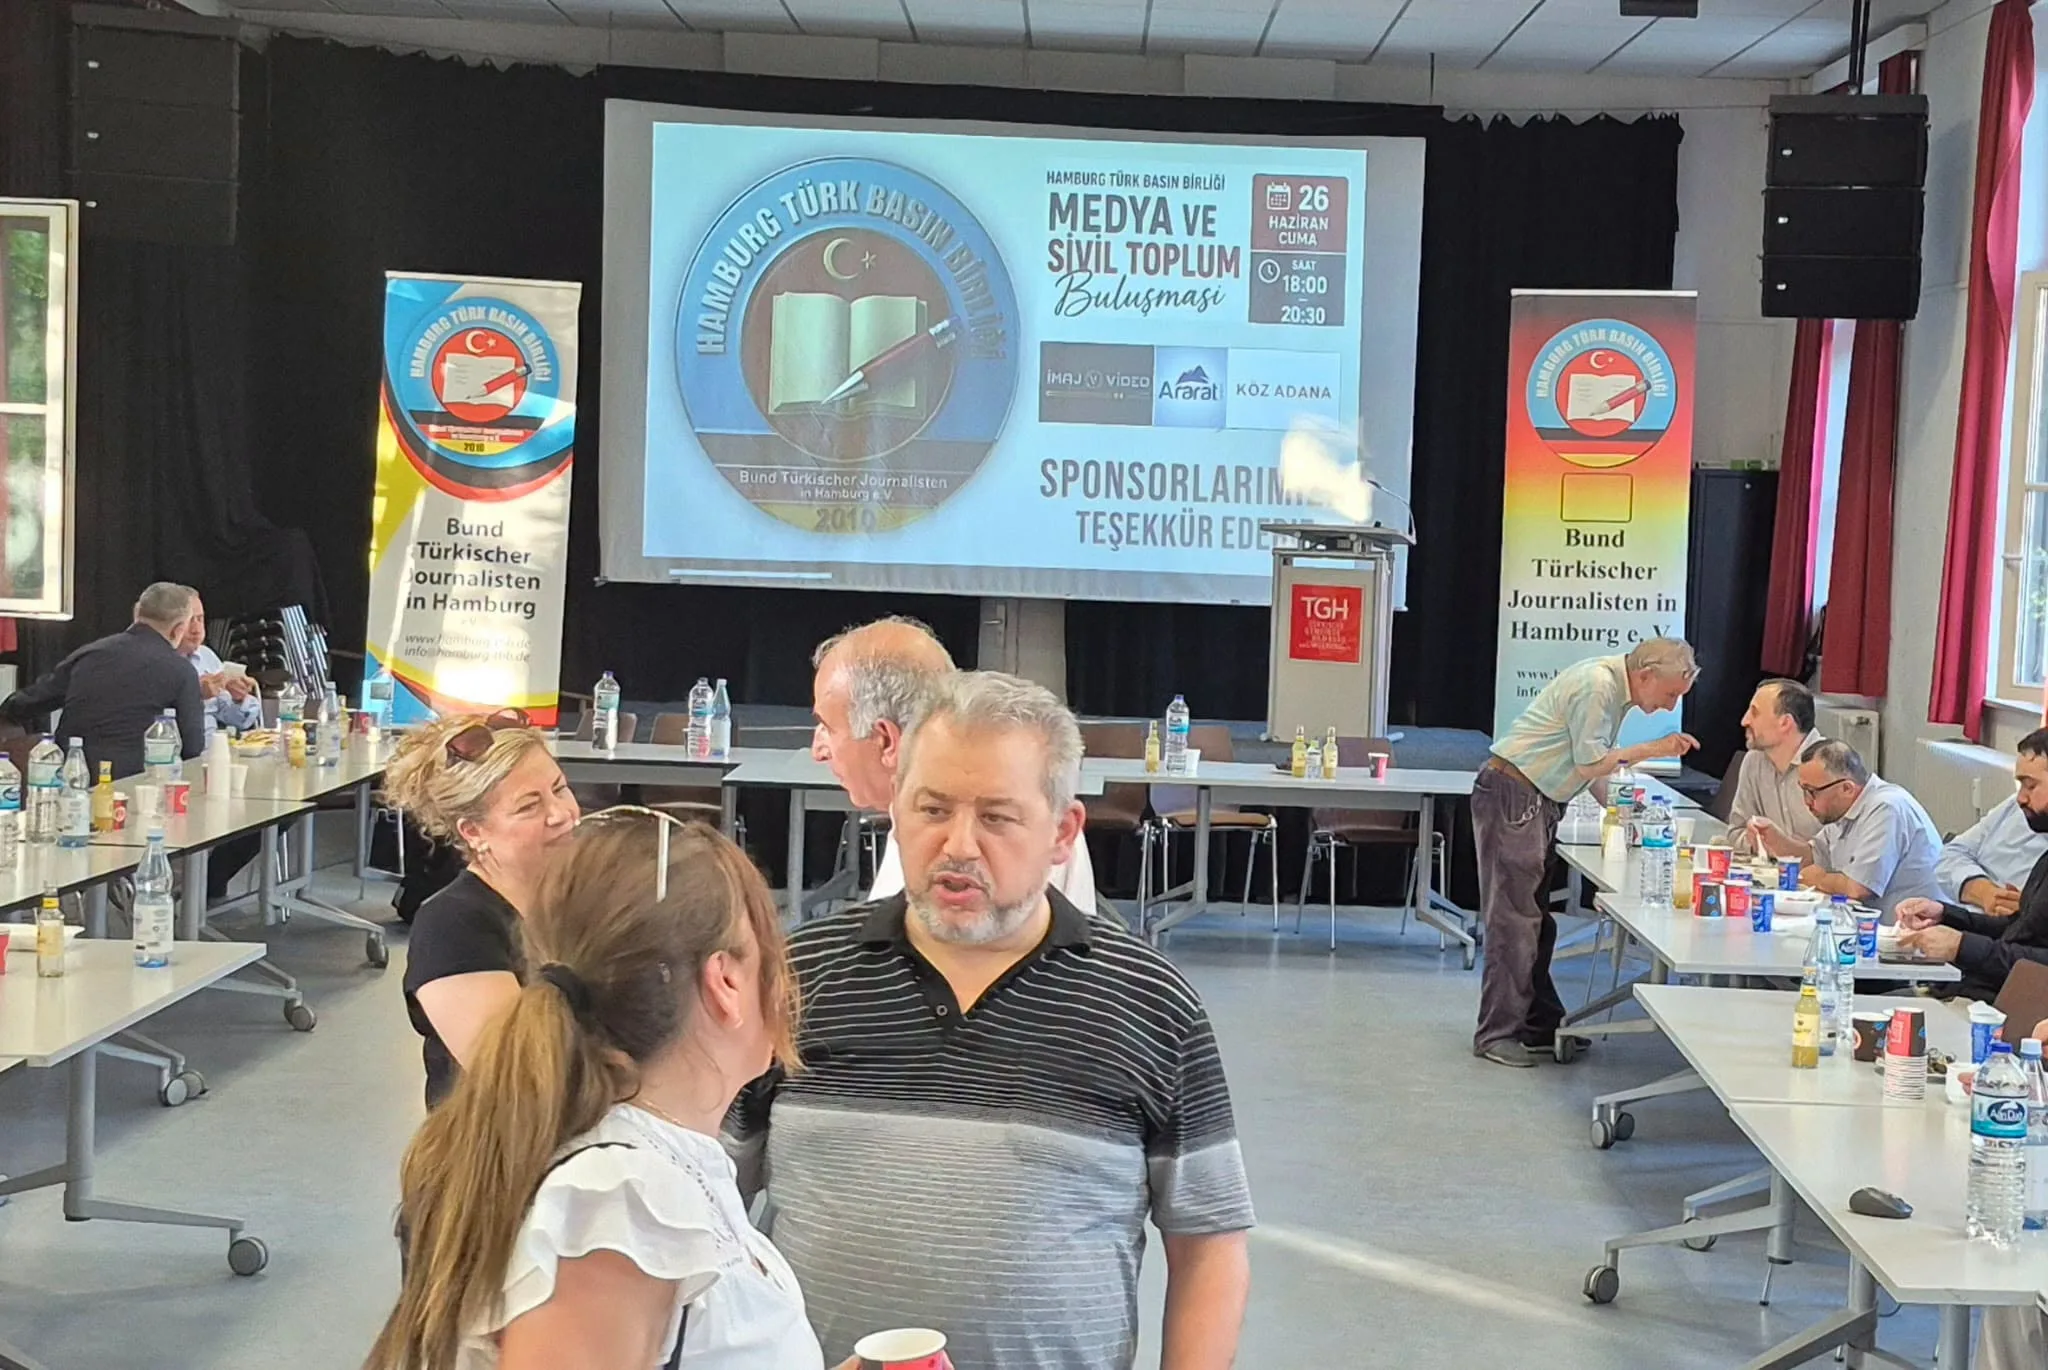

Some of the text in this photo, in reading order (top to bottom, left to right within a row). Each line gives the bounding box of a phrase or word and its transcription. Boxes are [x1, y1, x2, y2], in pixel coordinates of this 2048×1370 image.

[1047, 170, 1226, 191] HAMBURG TÜRK BASIN BİRLİĞİ
[1298, 185, 1329, 212] 26
[1049, 192, 1217, 237] MEDYA VE
[1269, 213, 1329, 231] HAZİRAN
[1278, 232, 1318, 247] CUMA
[696, 207, 784, 355] HAMBURG
[779, 178, 860, 225] TÜRK
[866, 183, 956, 252] BASIN
[1047, 232, 1241, 279] SİVİL TOPLUM
[1291, 259, 1317, 271] SAAT
[1282, 275, 1327, 294] 18:00
[1281, 306, 1326, 325] 20:30
[1159, 381, 1218, 401] Ararat
[1236, 380, 1332, 400] KÖZ ADANA
[739, 470, 948, 489] Bund Türkischer Journalisten
[1040, 458, 1323, 506] SPONSORLARIM
[800, 489, 811, 499] in
[815, 488, 870, 502] Hamburg
[446, 517, 504, 538] Bund
[814, 506, 877, 533] 2010
[1076, 507, 1213, 551] TEŞEKKÜR
[1565, 528, 1625, 548] Bund
[417, 541, 532, 564] Türkischer
[1532, 558, 1658, 580] Türkischer
[406, 591, 537, 620] in Hamburg
[1301, 596, 1349, 620] TGH
[1507, 589, 1677, 612] Journalisten in
[1510, 621, 1619, 648] Hamburg
